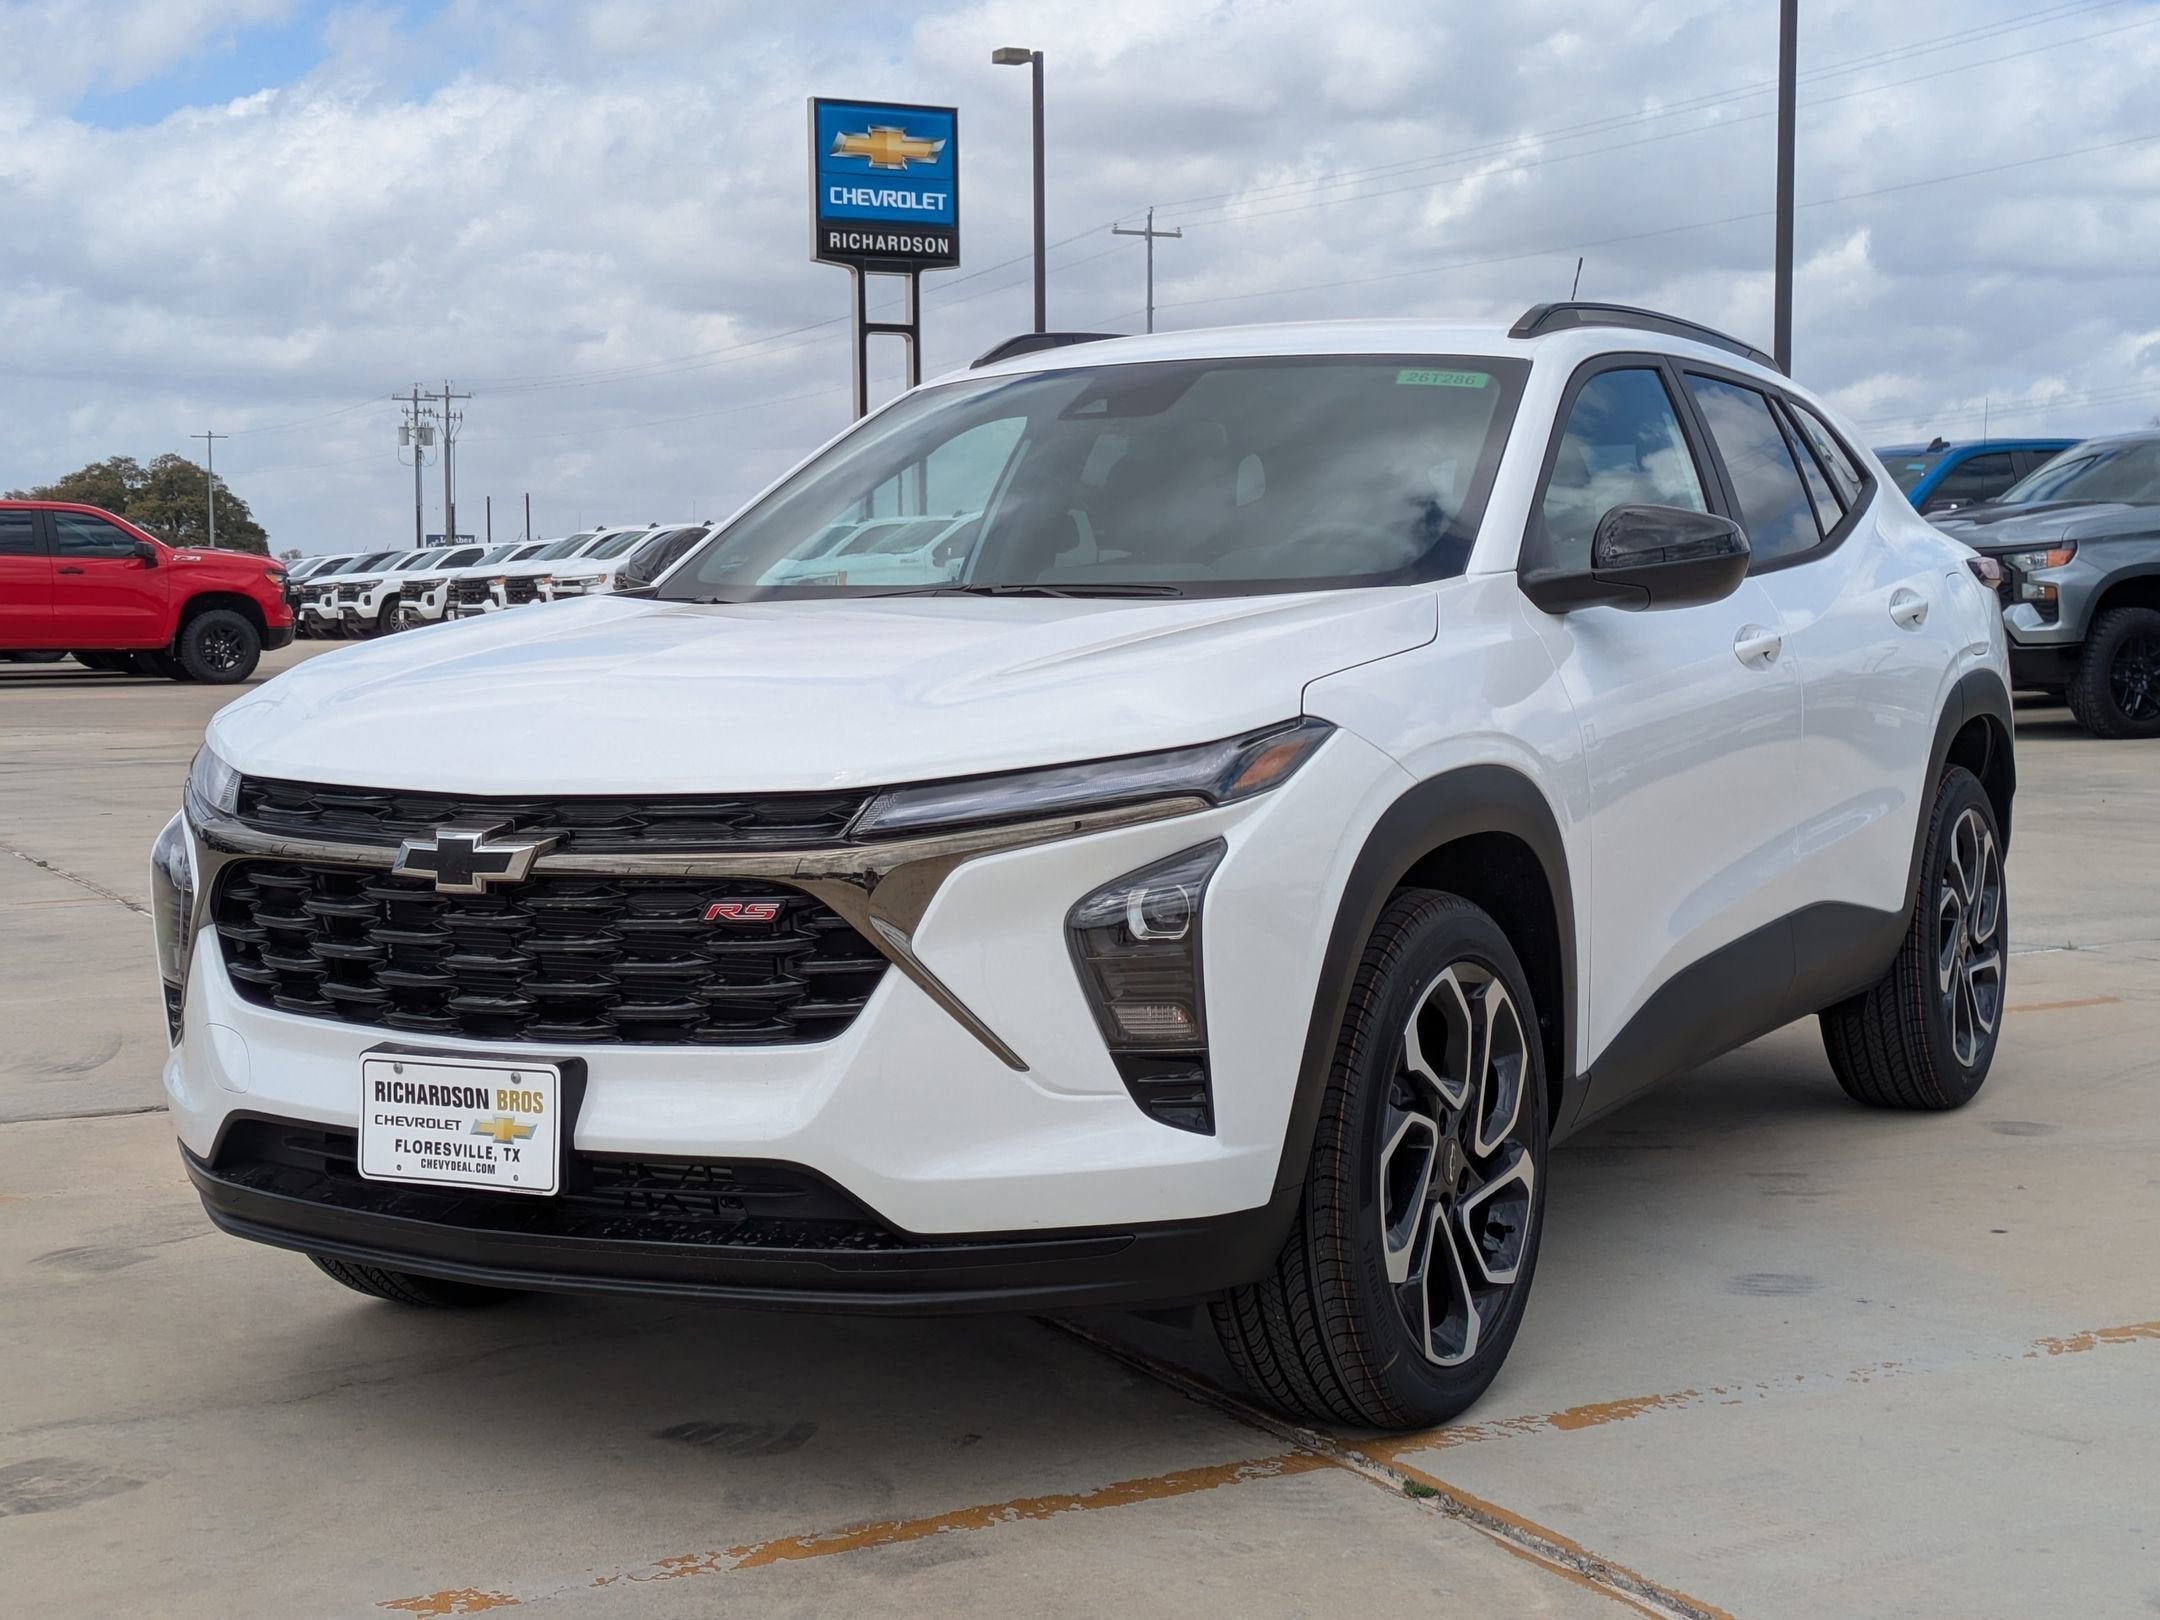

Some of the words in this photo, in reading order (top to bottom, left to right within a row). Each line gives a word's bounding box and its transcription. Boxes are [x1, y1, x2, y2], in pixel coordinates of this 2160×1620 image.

[829, 186, 947, 211] CHEVROLET
[829, 231, 949, 254] RICHARDSON
[1405, 371, 1475, 386] 26T286
[704, 903, 779, 920] RS
[374, 1081, 490, 1110] RICHARDSON
[496, 1089, 544, 1114] BROS
[374, 1114, 462, 1131] CHEVROLET
[395, 1138, 498, 1162] FLORESVILLE,
[503, 1147, 521, 1163] TX
[420, 1158, 496, 1175] CHEVYDEAL.COM
